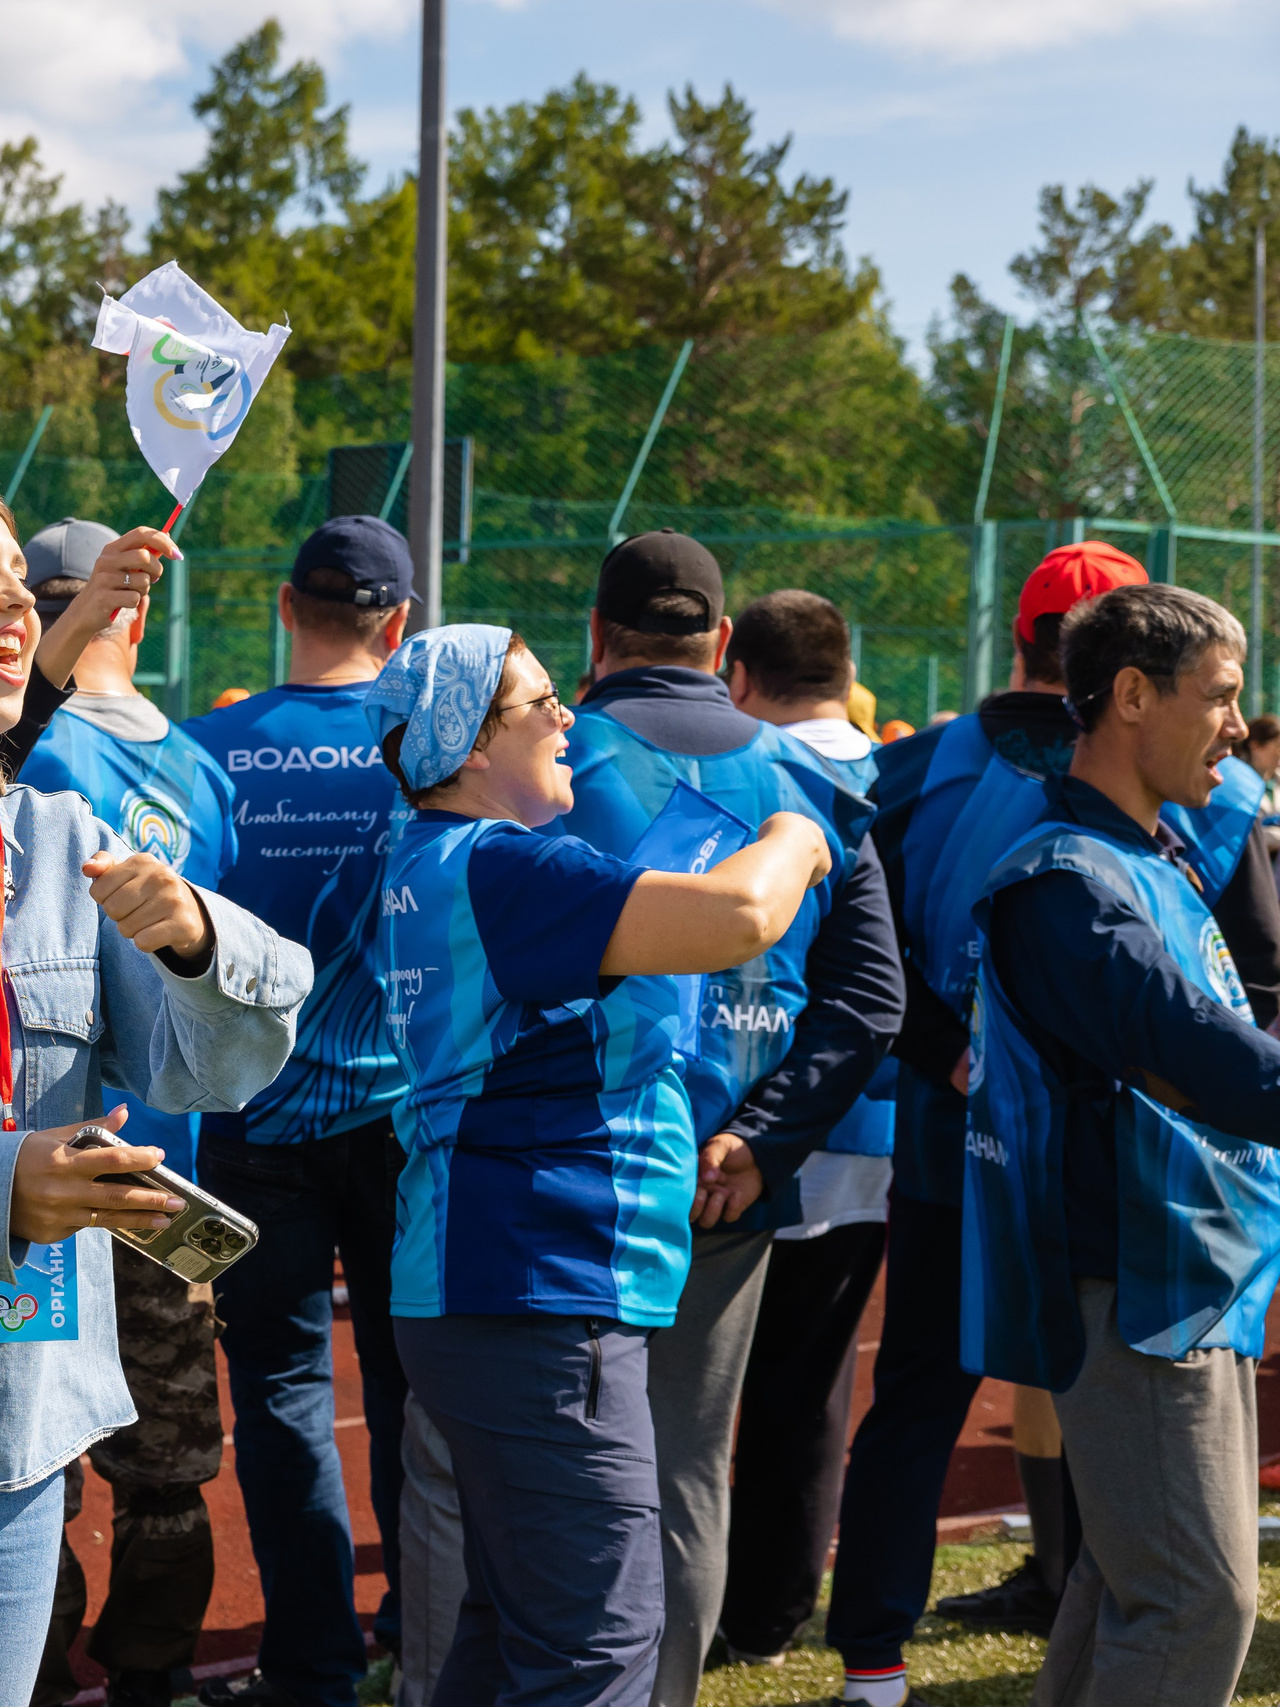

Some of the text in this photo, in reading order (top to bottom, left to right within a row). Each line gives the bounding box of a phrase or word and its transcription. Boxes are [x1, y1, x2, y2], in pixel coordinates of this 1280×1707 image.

[228, 745, 384, 772] ВОДОКА
[233, 799, 378, 833] Любимому
[261, 843, 365, 875] чистую
[49, 1243, 66, 1328] ОРГАНИ
